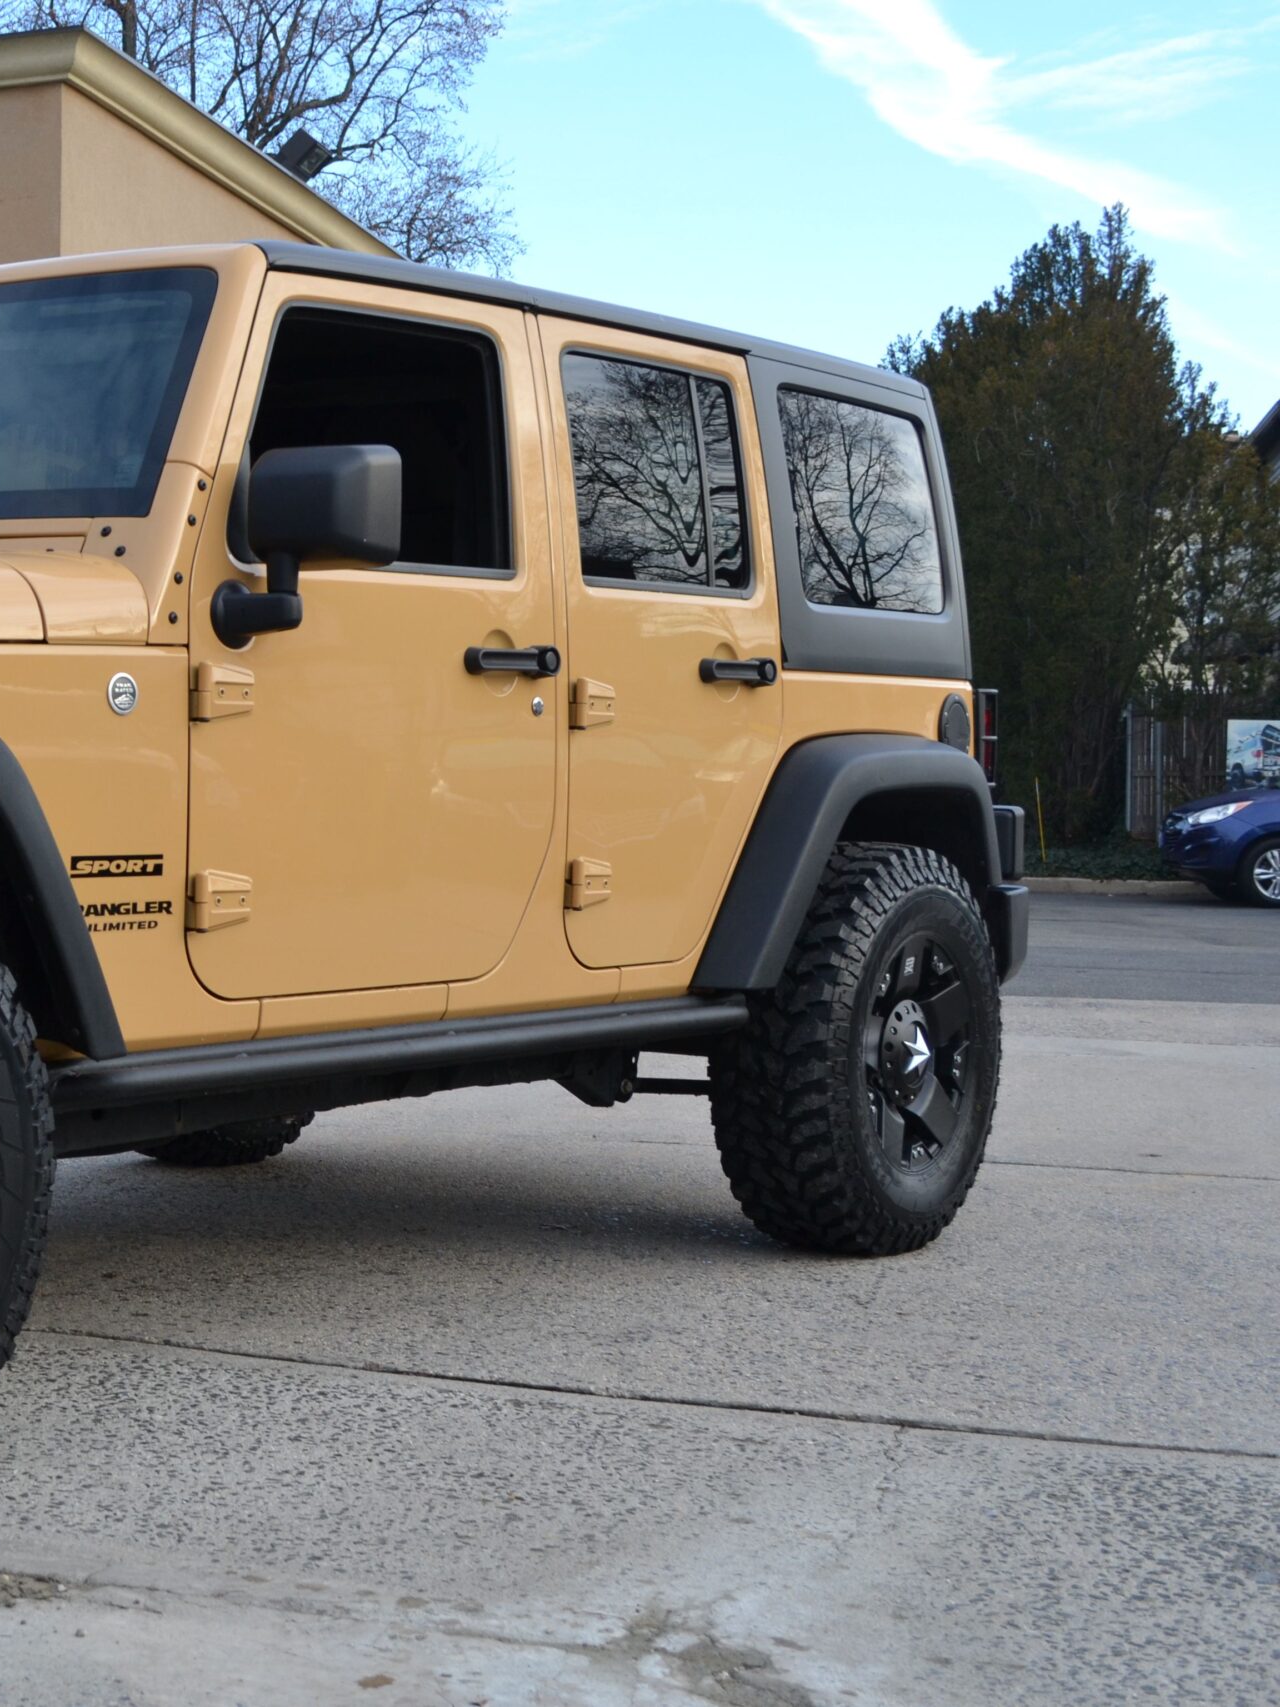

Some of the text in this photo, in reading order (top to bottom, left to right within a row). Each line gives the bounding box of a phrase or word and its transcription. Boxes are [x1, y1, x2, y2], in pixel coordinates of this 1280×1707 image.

[71, 855, 163, 877] SPORT
[80, 901, 173, 917] ANGLER
[88, 920, 158, 932] LIMITED
